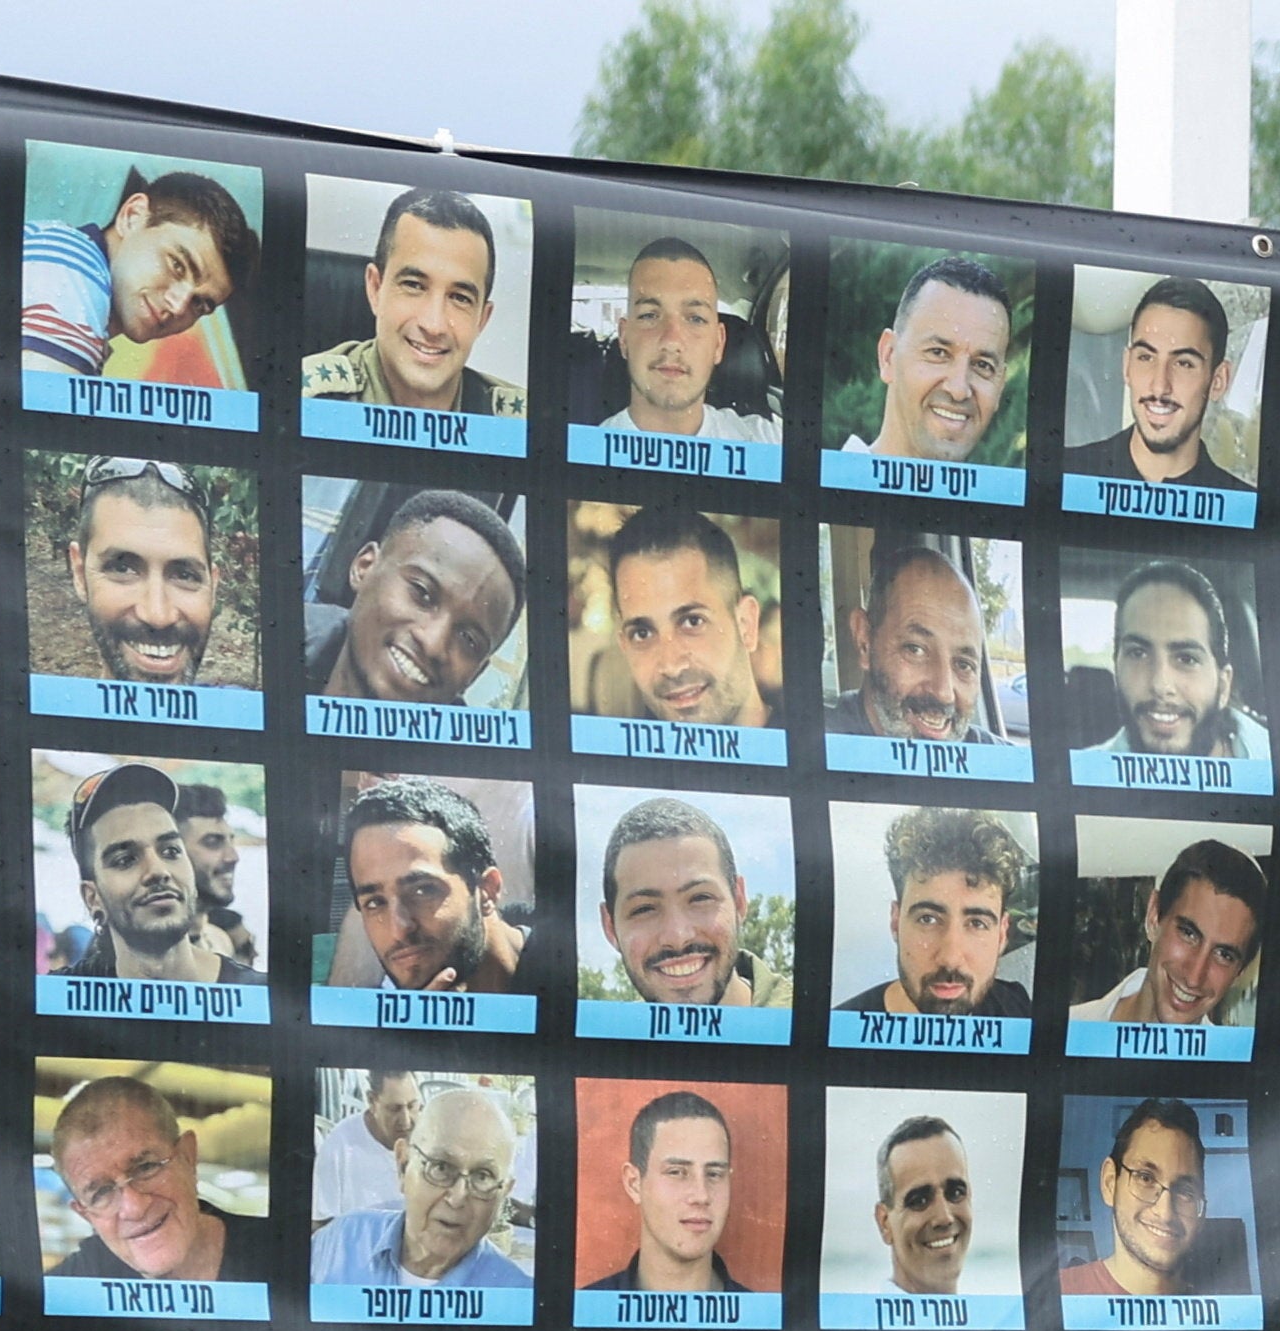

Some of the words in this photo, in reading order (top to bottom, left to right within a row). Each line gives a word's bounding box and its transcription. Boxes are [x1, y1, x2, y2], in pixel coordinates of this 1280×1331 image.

[68, 377, 132, 415] הרקין
[139, 384, 212, 425] מקסים
[363, 406, 417, 442] חממי
[423, 412, 468, 448] אסף
[604, 432, 711, 474] קופרשטיין
[723, 444, 746, 476] בר
[872, 459, 934, 493] שרעבי
[940, 466, 977, 498] יוסי
[1098, 481, 1189, 518] ברסלבסקי
[1193, 491, 1225, 522] רום
[97, 683, 138, 716] אדר
[144, 687, 198, 720] תמיר
[318, 699, 368, 735] מולל
[374, 706, 443, 741] לואיטו
[620, 722, 665, 756] ברוך
[670, 723, 740, 759] אוריאל
[891, 739, 918, 771] לוי
[924, 744, 969, 776] איתן
[1111, 755, 1191, 787] צנגאוקר
[1195, 759, 1232, 791] מתן
[66, 980, 133, 1013] אוחנה
[140, 983, 188, 1016] חיים
[194, 986, 242, 1021] יוסף
[376, 993, 411, 1027] כהן
[418, 994, 475, 1026] נמרוד
[649, 1005, 671, 1039] חן
[677, 1006, 723, 1037] איתי
[859, 1013, 908, 1045] דלאל
[912, 1016, 966, 1047] גלבוע
[971, 1019, 1002, 1048] גיא
[1116, 1024, 1168, 1057] גולדין
[1173, 1028, 1207, 1057] הדר
[101, 1281, 175, 1313] גודארד
[181, 1284, 214, 1314] מני
[361, 1287, 412, 1322] קופר
[418, 1288, 483, 1320] עמירם
[617, 1293, 687, 1323] נאוטרה
[693, 1294, 740, 1324] עומר
[920, 1298, 968, 1326] עמרי
[1108, 1298, 1167, 1326] נמרודי
[1171, 1299, 1220, 1325] תמיר
[875, 1298, 916, 1329] מירן
